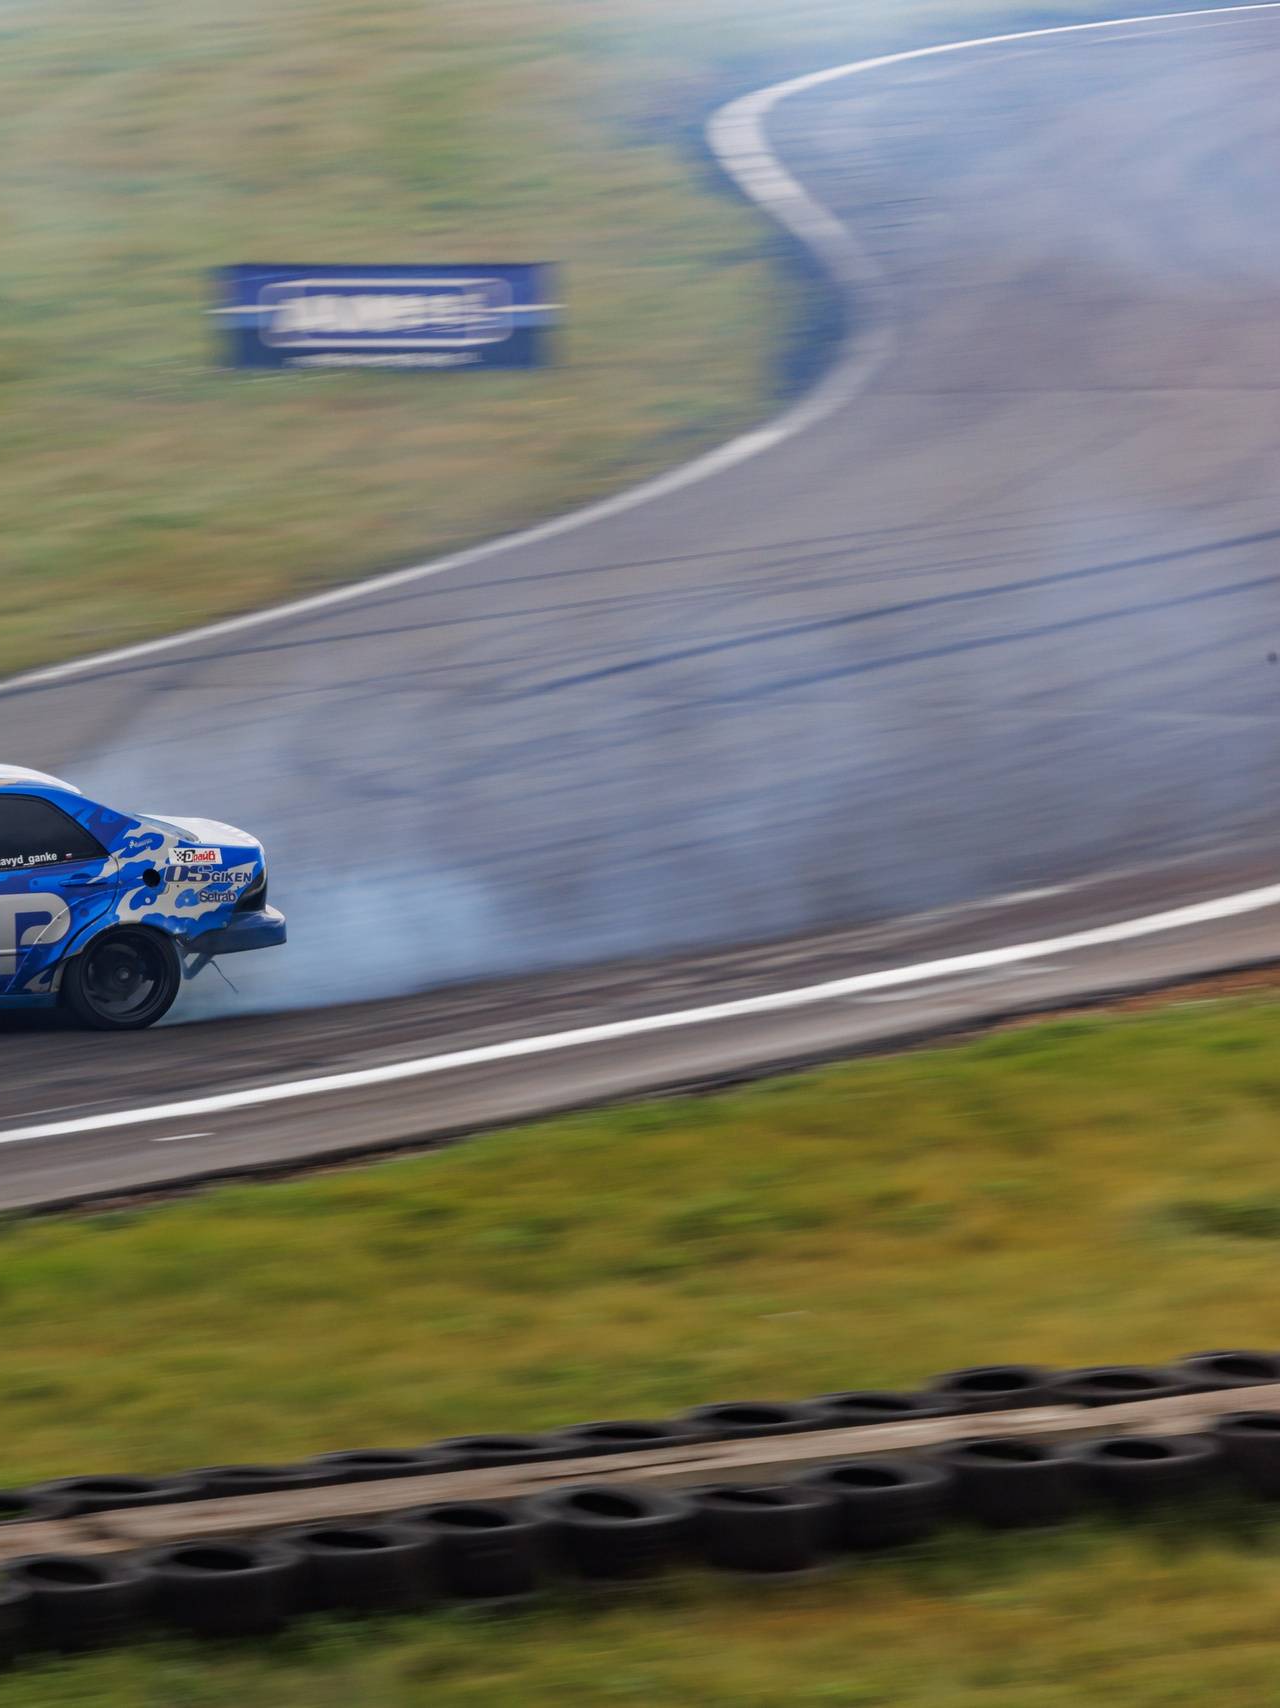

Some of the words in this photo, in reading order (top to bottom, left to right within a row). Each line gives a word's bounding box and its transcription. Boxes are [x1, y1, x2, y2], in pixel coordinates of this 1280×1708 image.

[164, 864, 213, 882] OS
[211, 872, 253, 883] GIKEN
[199, 890, 238, 903] Setrab
